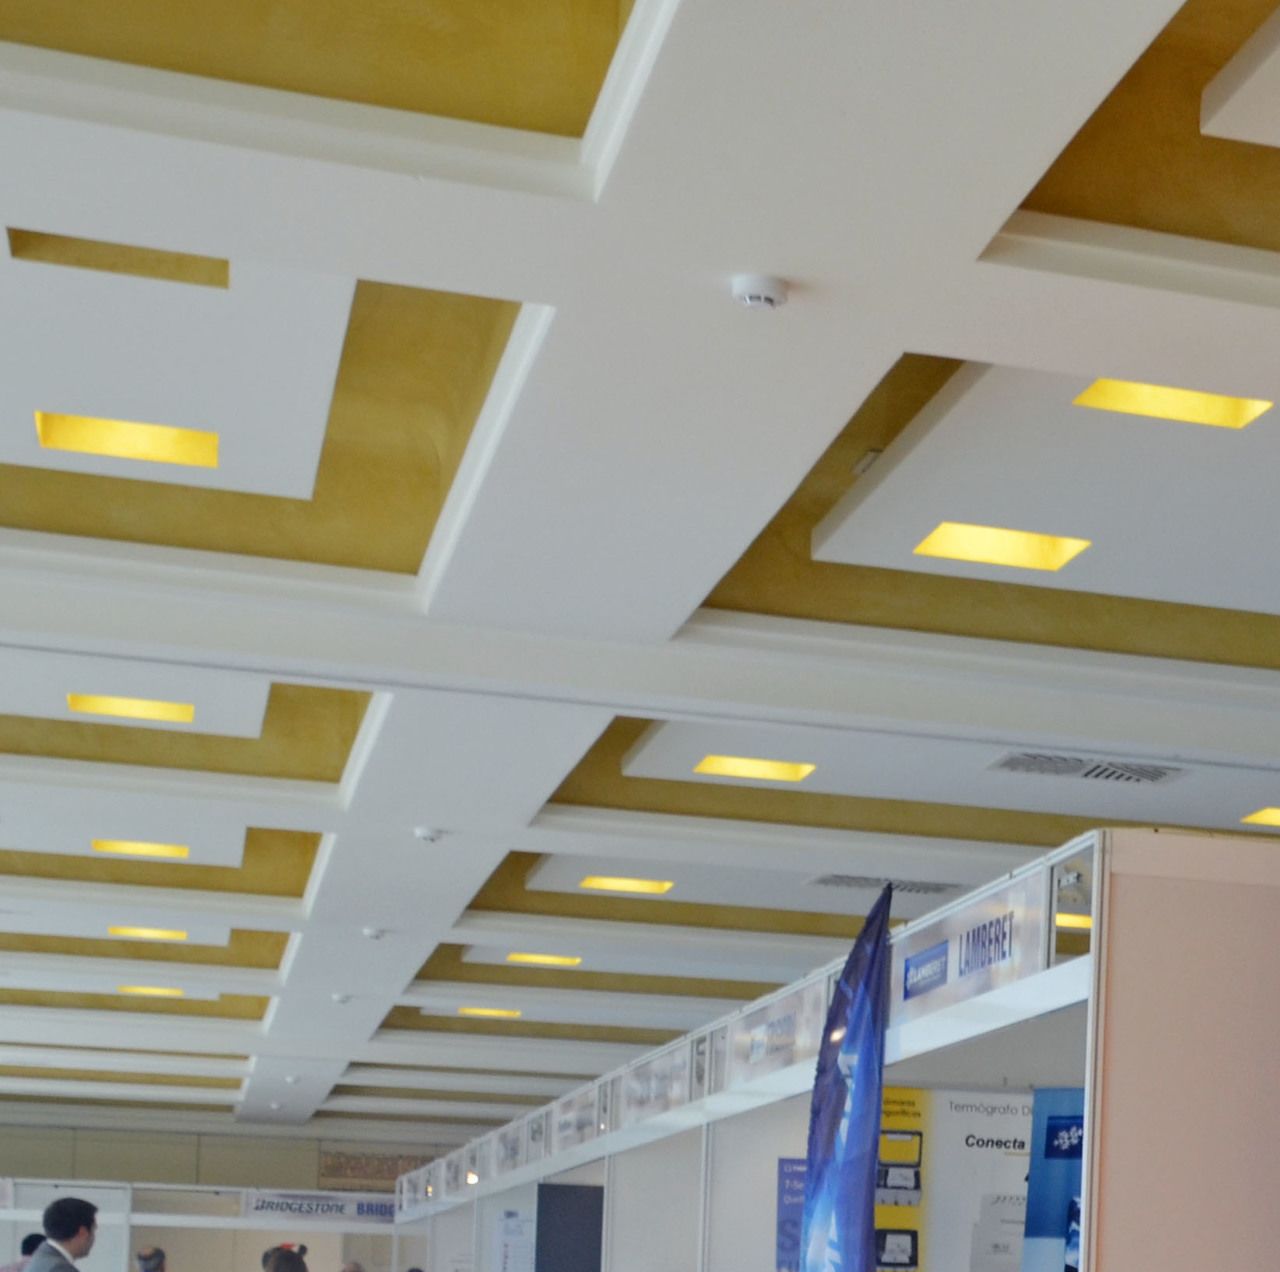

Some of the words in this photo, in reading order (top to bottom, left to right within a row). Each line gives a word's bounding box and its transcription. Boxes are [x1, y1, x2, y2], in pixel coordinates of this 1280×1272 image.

[958, 910, 1014, 977] LAMBERET
[965, 1134, 1026, 1150] Conecta
[253, 1198, 347, 1215] BRIDGESTONE
